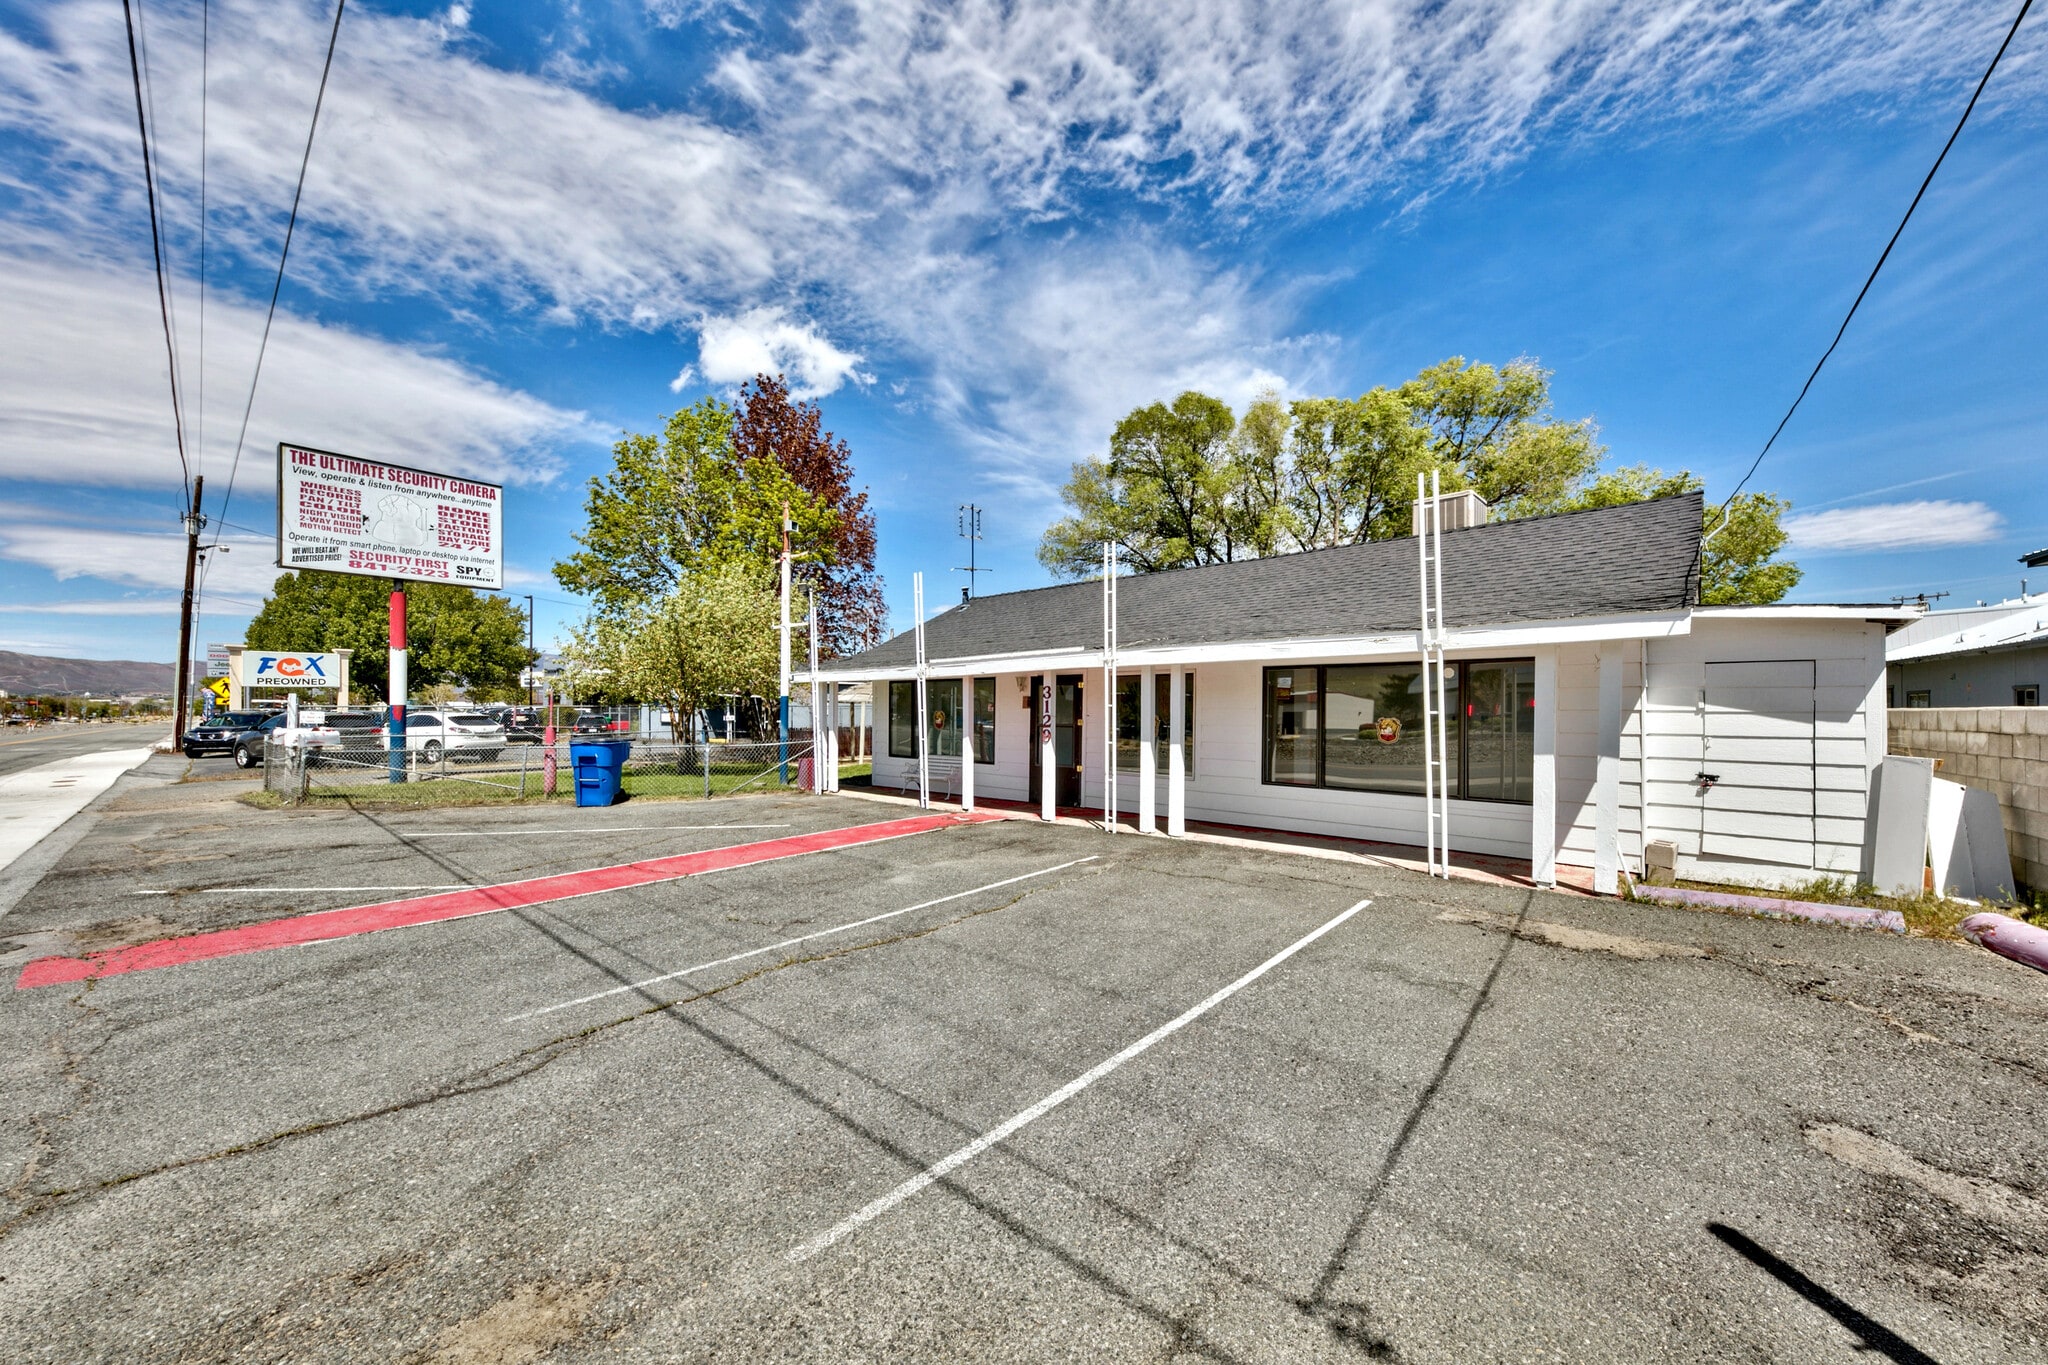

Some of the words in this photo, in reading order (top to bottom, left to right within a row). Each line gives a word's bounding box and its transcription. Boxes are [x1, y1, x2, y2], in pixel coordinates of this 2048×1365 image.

[290, 449, 316, 467] THE
[320, 455, 384, 480] ULTIMATE
[388, 468, 447, 491] SECURITY
[450, 480, 496, 501] CAMERA
[292, 466, 318, 478] View,
[321, 472, 356, 485] operate
[359, 478, 366, 486] &
[368, 480, 392, 491] listen
[394, 484, 414, 495] from
[300, 480, 361, 497] WIRELESS
[300, 487, 361, 503] RECORDS
[299, 501, 362, 515] COLOR
[300, 494, 325, 503] PAN
[337, 499, 361, 509] TILT
[299, 508, 328, 518] NIGHT
[330, 512, 361, 522] VISION
[438, 505, 491, 518] HOME
[438, 511, 491, 524] OFFICE
[299, 515, 330, 525] 2-WAY
[333, 519, 361, 529] AUDIO
[299, 522, 331, 532] MOTION
[333, 527, 361, 536] DETECT
[438, 517, 491, 530] STORE
[438, 523, 491, 535] FACTORY
[438, 529, 490, 541] STORAGE
[438, 535, 460, 543] DAY
[463, 539, 490, 548] CARE
[288, 531, 320, 544] Operate
[322, 536, 328, 544] it
[329, 537, 347, 547] from
[349, 541, 371, 550] smart
[373, 543, 397, 554] phone,
[400, 546, 423, 556] laptop
[432, 550, 458, 561] desktop
[470, 556, 495, 566] internet
[292, 547, 301, 555] WE
[315, 546, 328, 554] BEAT
[291, 554, 325, 563] ADVERTISED
[325, 553, 342, 562] PRICE!
[349, 549, 412, 567] SECURITY
[415, 558, 449, 570] FIRST
[348, 560, 449, 579] 841-2323
[456, 565, 482, 576] SPY
[455, 574, 494, 583] EQUIPMENT
[257, 655, 326, 677] FOX
[257, 677, 327, 686] PREOWNED
[1042, 685, 1052, 744] 3129
